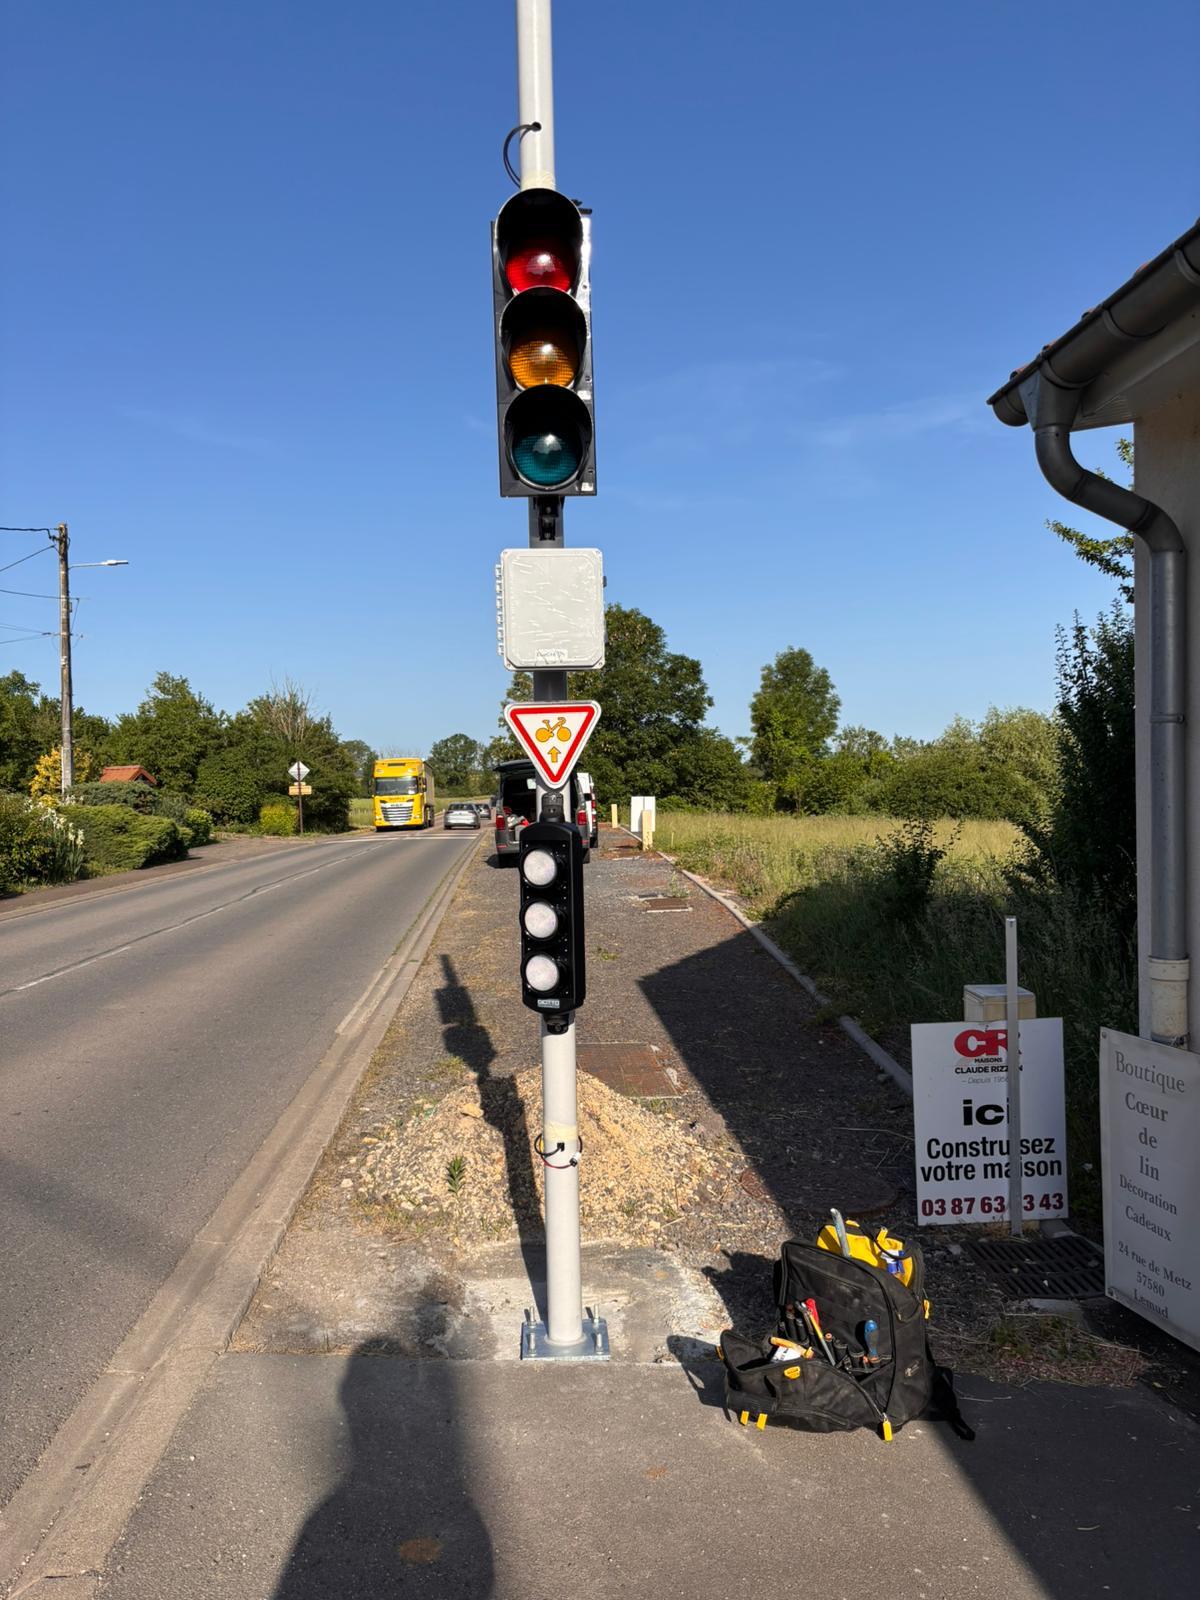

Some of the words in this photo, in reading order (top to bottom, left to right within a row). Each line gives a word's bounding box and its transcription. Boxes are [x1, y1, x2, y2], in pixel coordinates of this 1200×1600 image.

[955, 1066, 990, 1074] CLAUDE
[1114, 1050, 1185, 1094] Boutique
[1125, 1091, 1168, 1122] Cœur
[926, 1137, 1056, 1159] Construsez
[1138, 1127, 1158, 1149] de
[920, 1161, 976, 1182] votre
[1139, 1155, 1160, 1181] lin
[921, 1199, 946, 1216] 03
[950, 1197, 975, 1215] 87
[979, 1195, 1006, 1214] 63
[1039, 1192, 1064, 1210] 43
[1119, 1174, 1178, 1215] Décoration
[1125, 1205, 1172, 1242] Cadeaux
[1118, 1240, 1129, 1256] 24
[1131, 1250, 1146, 1268] rue
[1148, 1260, 1161, 1275] de
[1163, 1267, 1192, 1290] Metz
[1136, 1271, 1165, 1297] 57580
